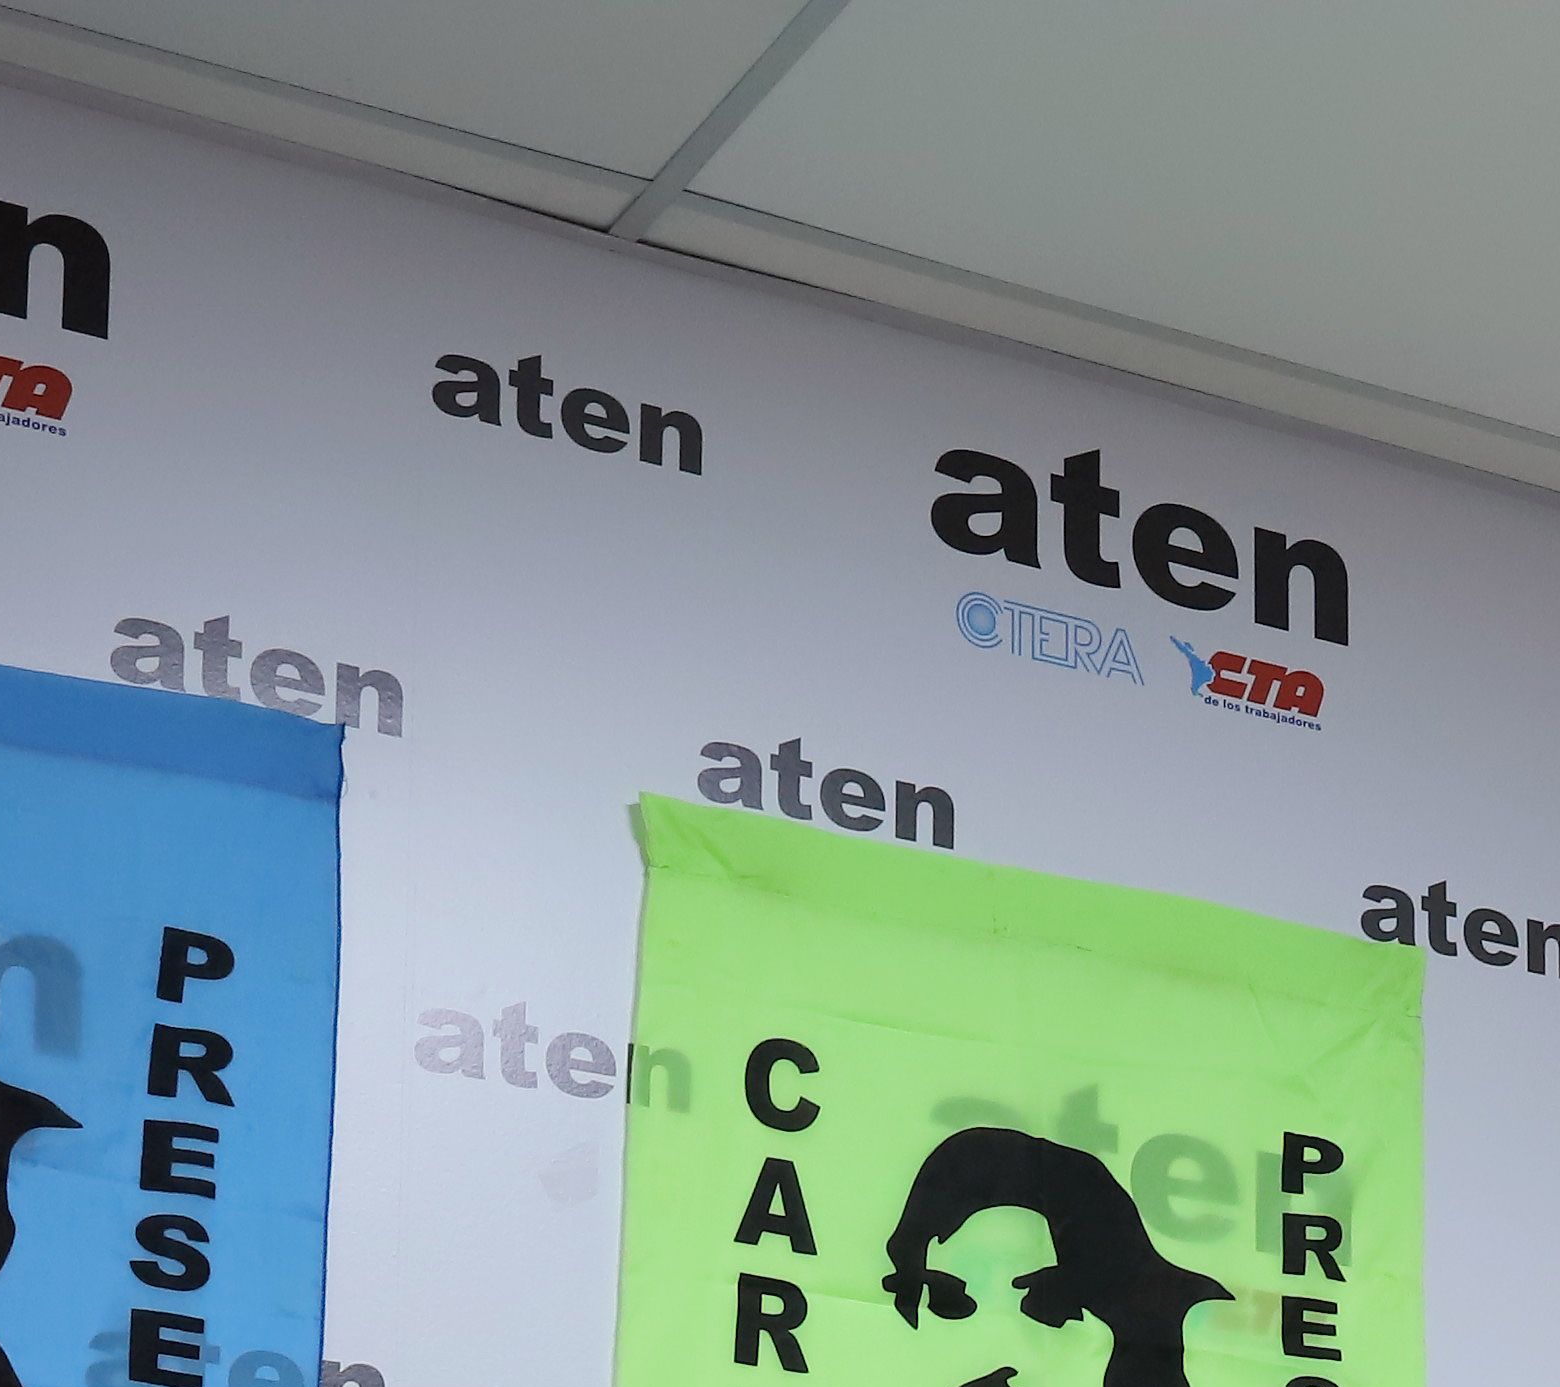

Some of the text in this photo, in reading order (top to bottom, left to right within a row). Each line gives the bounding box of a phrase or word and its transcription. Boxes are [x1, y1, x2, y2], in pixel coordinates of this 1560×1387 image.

[431, 353, 703, 476] aten
[930, 448, 1350, 646] aten
[109, 615, 405, 738] aten
[1203, 695, 1323, 732] de los trabajadores
[1207, 650, 1325, 718] CTA
[698, 737, 955, 850] aten
[413, 1000, 692, 1114] aten
